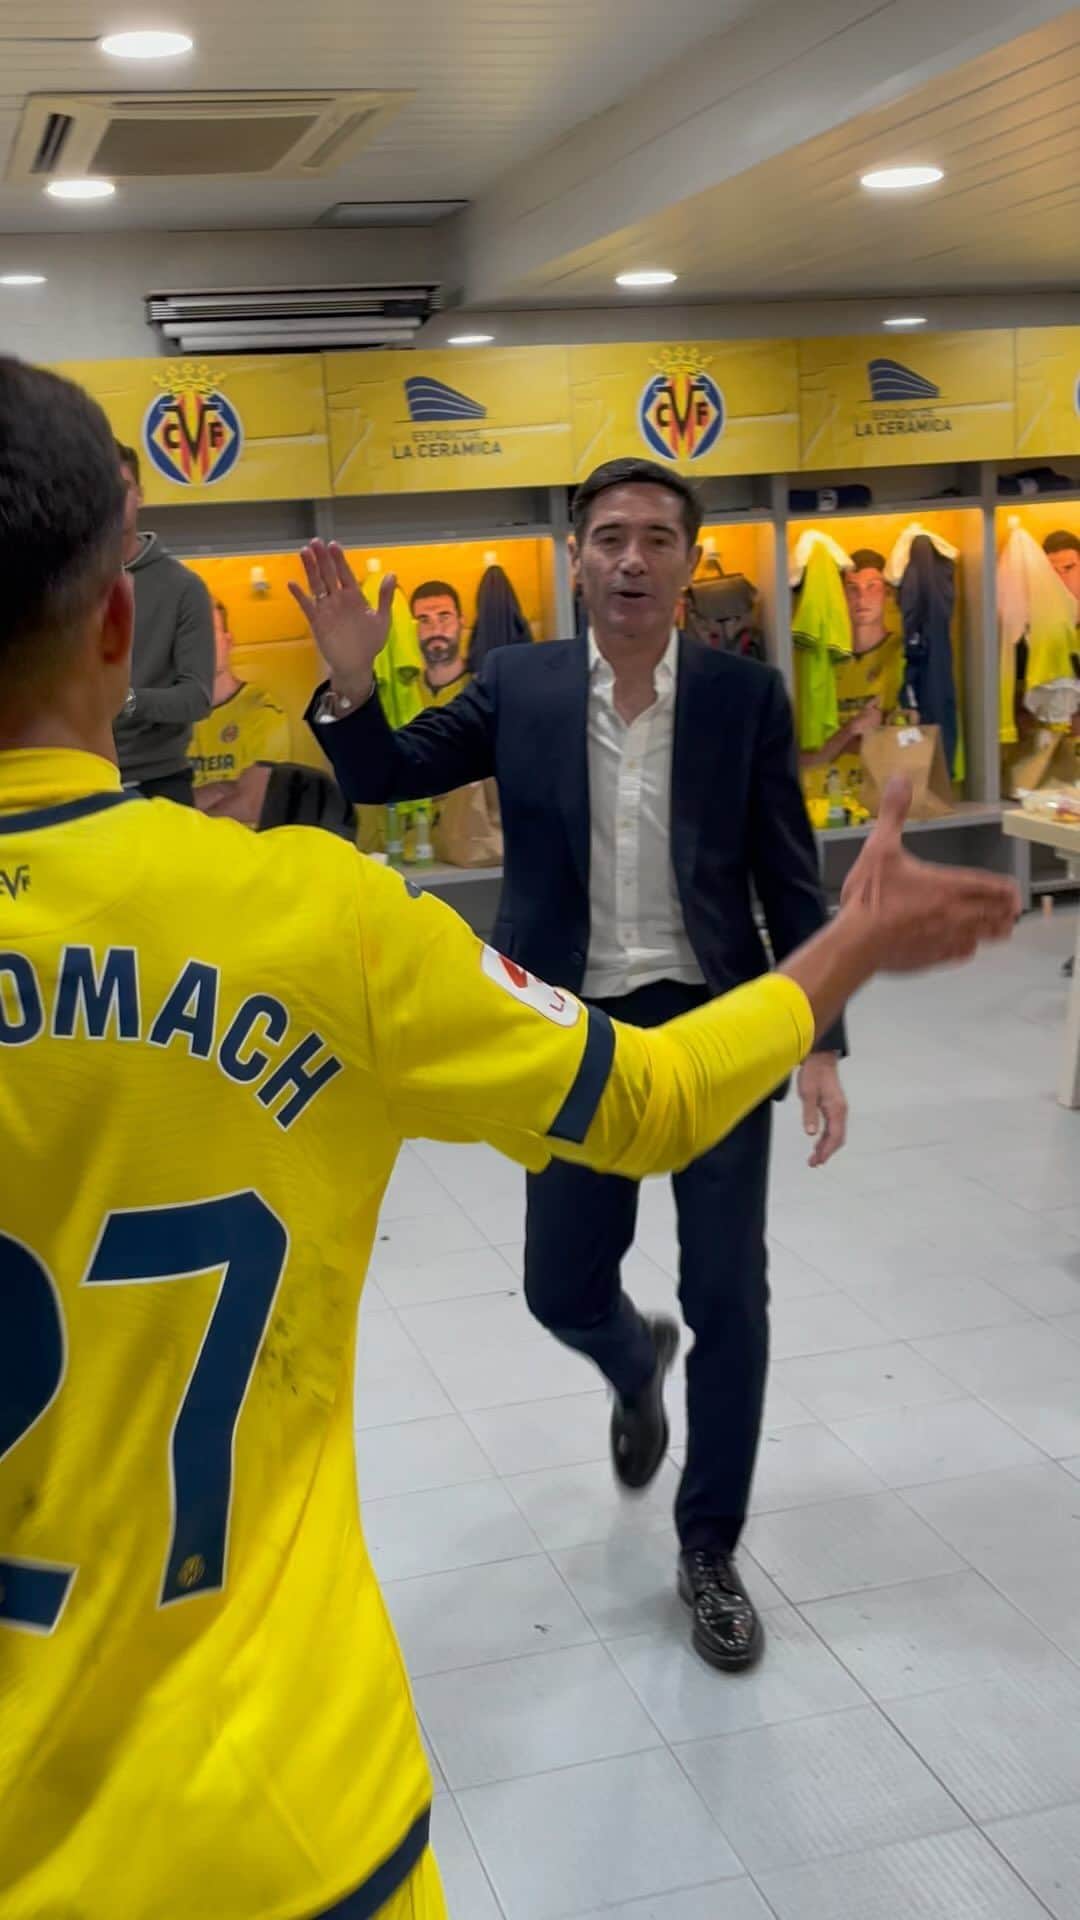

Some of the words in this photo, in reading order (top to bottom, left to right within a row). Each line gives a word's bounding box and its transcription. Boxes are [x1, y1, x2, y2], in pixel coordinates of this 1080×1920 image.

[855, 422, 873, 437] LA
[392, 443, 412, 460] LA
[0, 945, 344, 1132] OMACH
